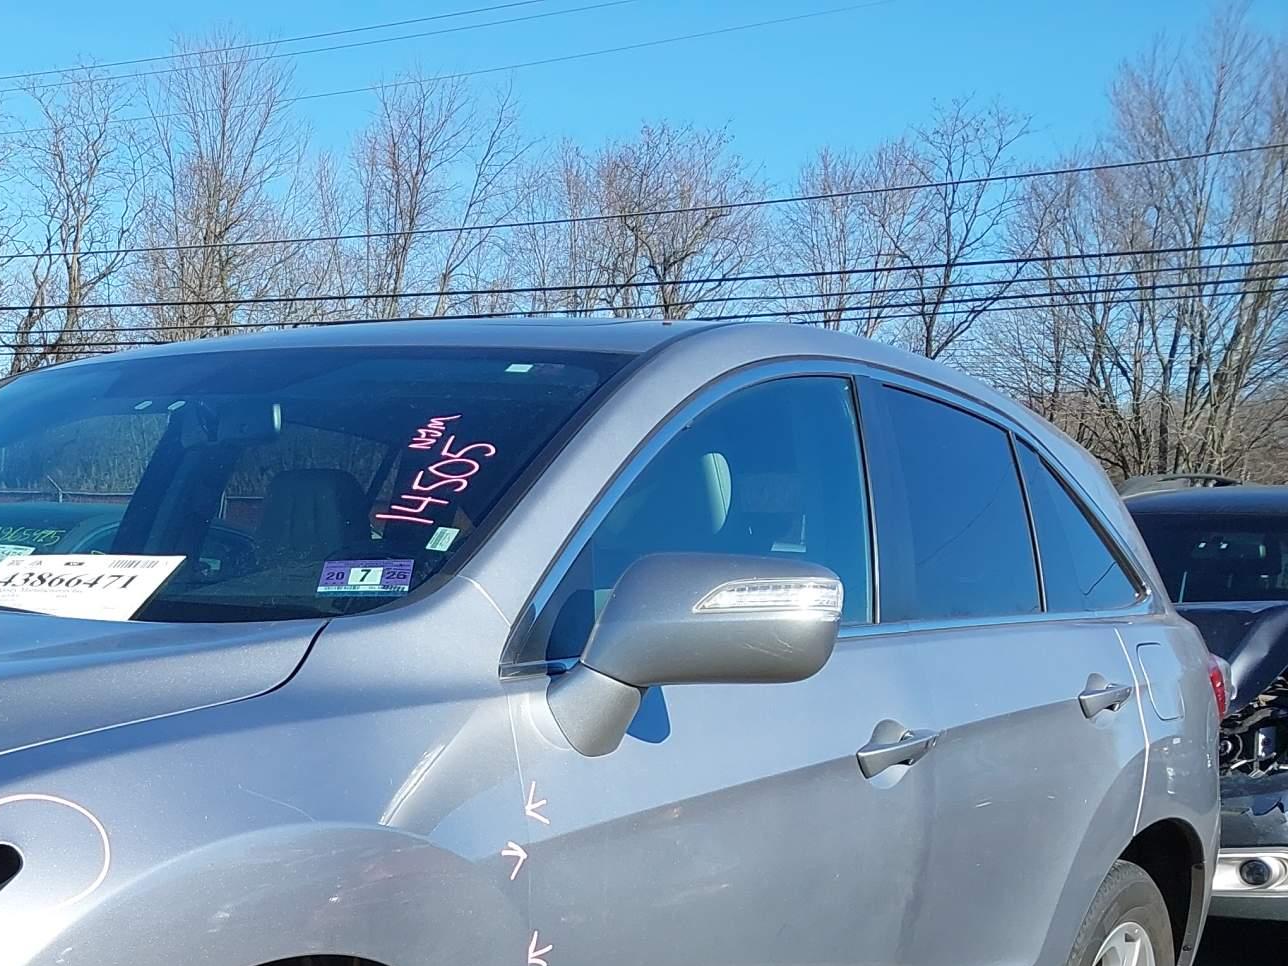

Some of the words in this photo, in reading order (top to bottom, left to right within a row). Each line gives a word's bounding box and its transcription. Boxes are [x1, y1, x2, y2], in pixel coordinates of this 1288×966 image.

[375, 435, 496, 524] 14505
[325, 571, 345, 581] 20
[359, 569, 372, 582] 7
[385, 570, 406, 580] 26
